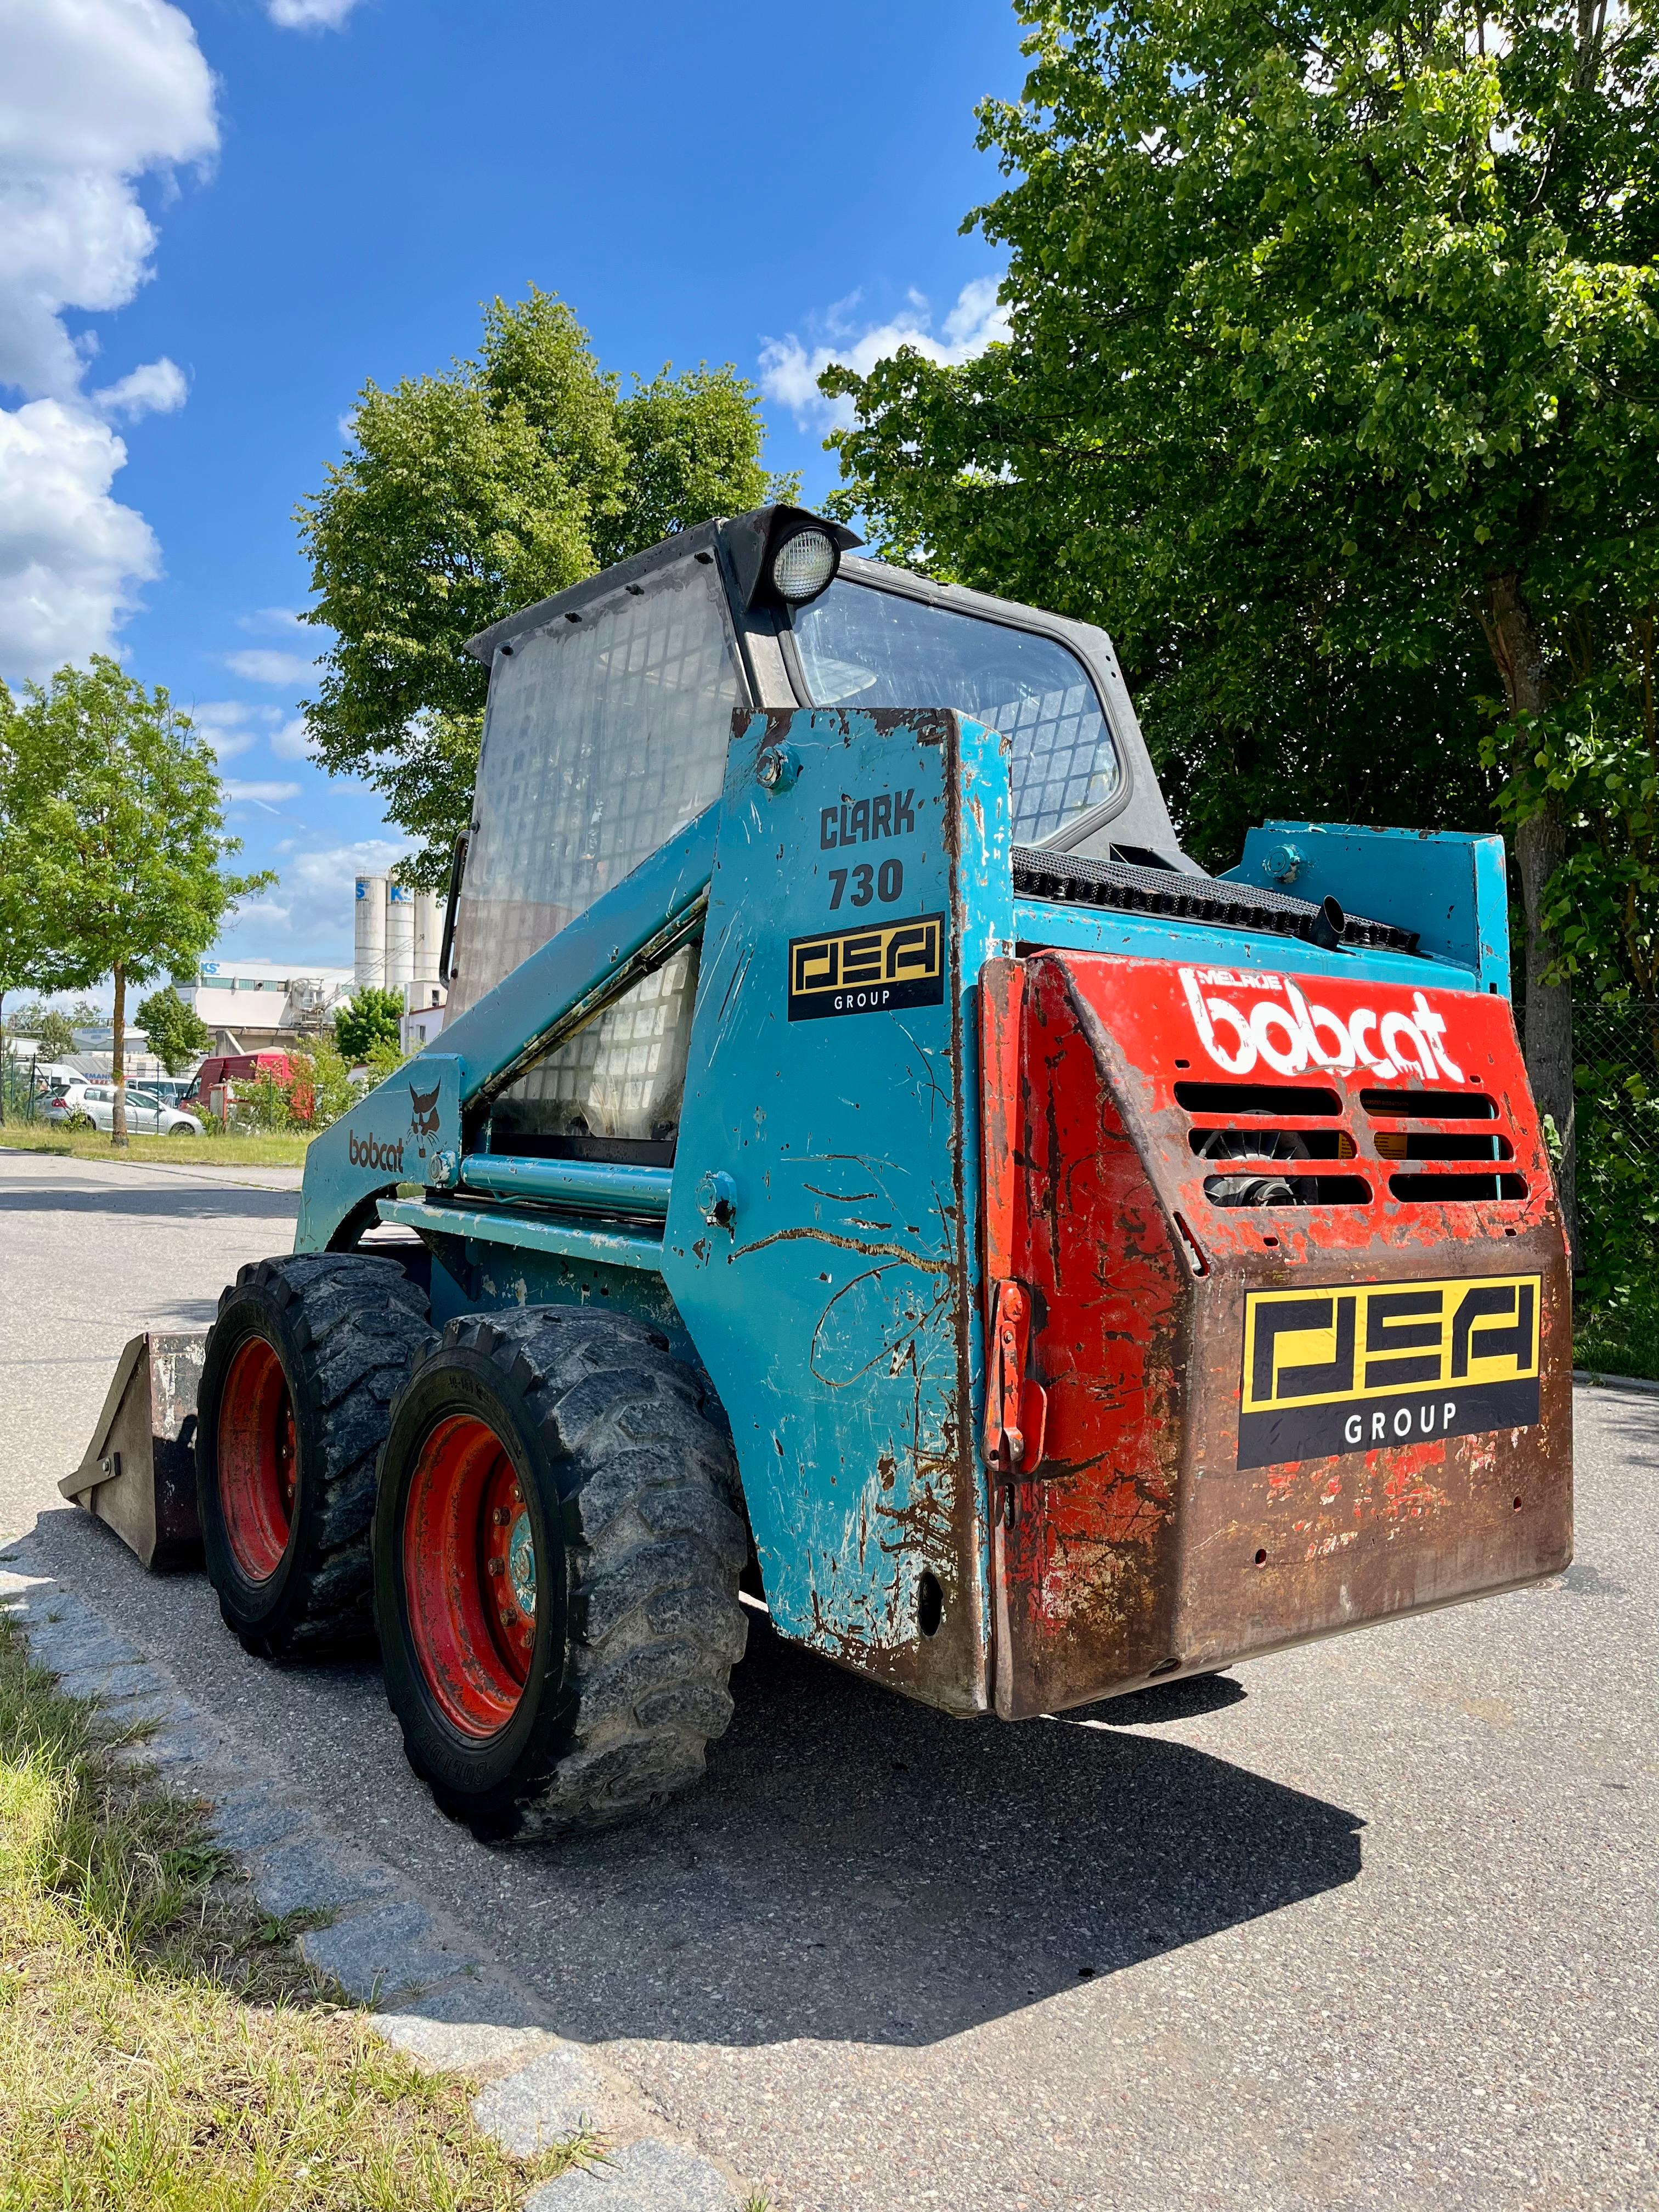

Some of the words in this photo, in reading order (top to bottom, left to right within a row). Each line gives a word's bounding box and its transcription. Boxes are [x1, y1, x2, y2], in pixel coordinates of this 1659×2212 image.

[820, 789, 915, 850] CLARK
[828, 859, 903, 910] 730
[834, 990, 890, 1009] GROUP
[1196, 970, 1283, 990] MELROE
[1178, 968, 1465, 1084] bobcat
[349, 1129, 404, 1173] bobcat
[1344, 1402, 1457, 1444] GROUP
